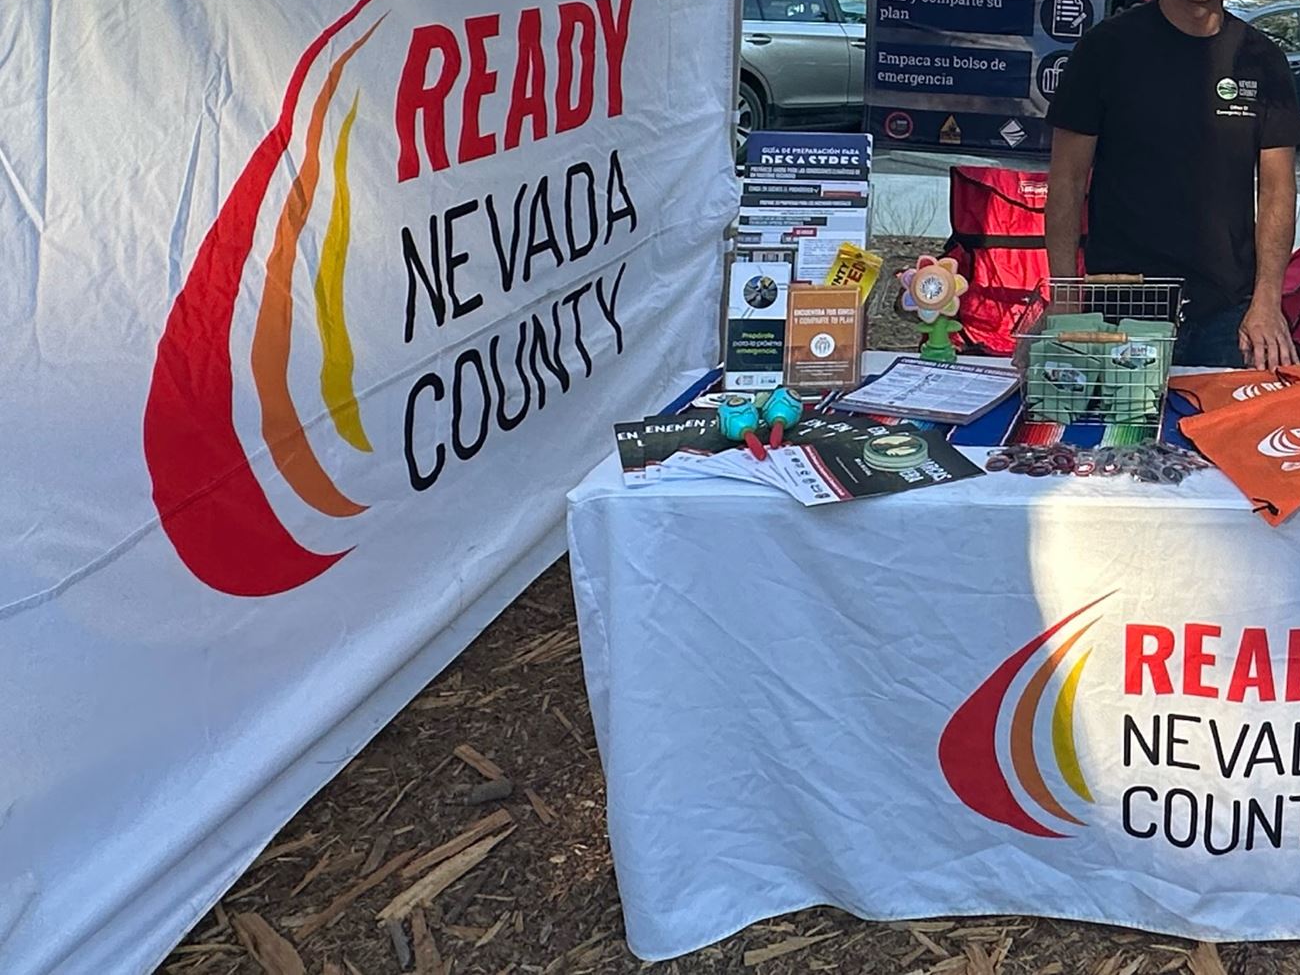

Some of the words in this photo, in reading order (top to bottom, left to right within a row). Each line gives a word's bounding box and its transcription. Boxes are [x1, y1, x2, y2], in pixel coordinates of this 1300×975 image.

[880, 6, 909, 20] plan
[878, 52, 931, 67] Empaca
[934, 57, 950, 67] su
[953, 56, 988, 69] bolso
[990, 59, 1006, 71] de
[877, 71, 953, 85] emergencia
[792, 147, 840, 155] PREPARACIÓN
[761, 155, 860, 164] DESASTRES
[402, 150, 637, 343] NEVADA
[405, 263, 626, 491] COUNTY
